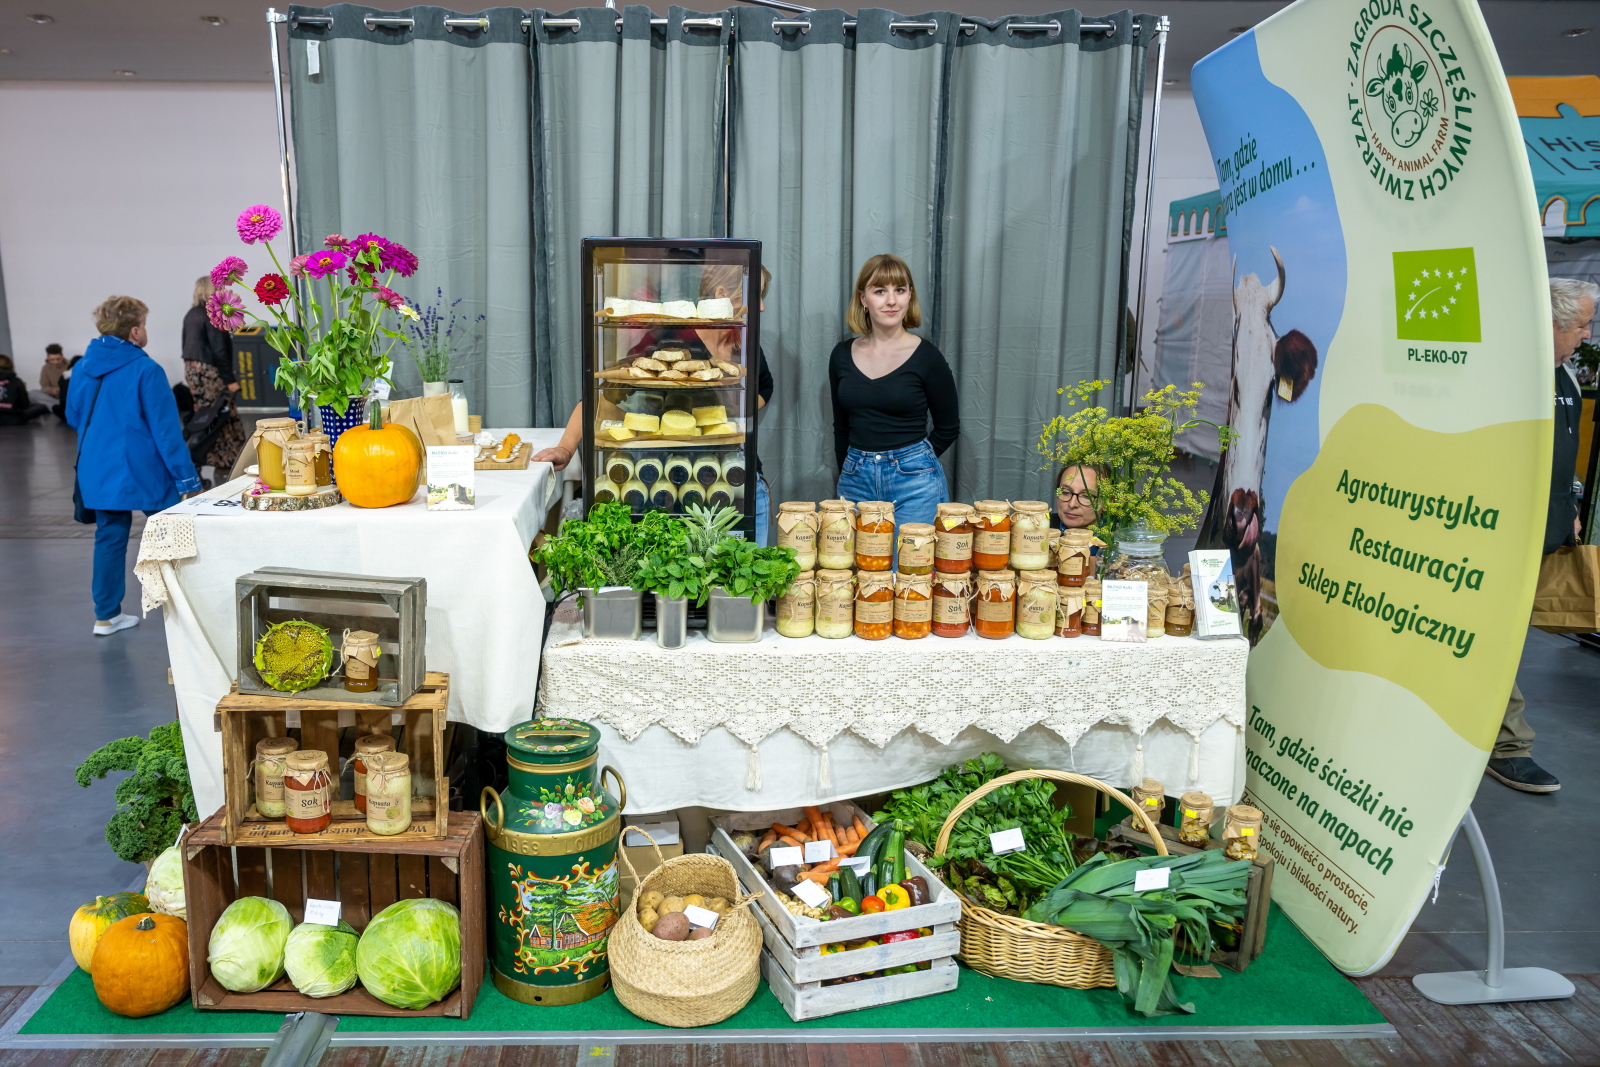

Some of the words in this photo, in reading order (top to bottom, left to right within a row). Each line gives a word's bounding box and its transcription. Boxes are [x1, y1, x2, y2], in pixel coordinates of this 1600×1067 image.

[1347, 0, 1405, 78] ZAGRODA
[1408, 3, 1477, 200] SZCZĘŚLIWYCH
[1233, 131, 1257, 181] gdzie
[1347, 92, 1415, 201] ZWIERZĄT
[1371, 132, 1397, 166] HAPPY
[1397, 153, 1434, 172] ANIMAL
[1431, 116, 1449, 155] FARM
[1248, 175, 1257, 199] w
[1407, 347, 1468, 365] PL-EKO-07
[1335, 469, 1500, 530] Agroturystyka
[955, 541, 969, 550] Sok
[1348, 527, 1485, 593] Restauracja
[1298, 562, 1340, 604] Sklep
[1341, 580, 1476, 659] Ekologiczny
[1248, 705, 1276, 749] Tam,
[1276, 736, 1320, 774] gdzie
[1318, 757, 1384, 815] ścieżki
[1377, 806, 1414, 838] nie
[301, 797, 318, 808] Sok
[1245, 745, 1298, 801] naczone
[1296, 791, 1320, 819] na
[1318, 808, 1394, 876] mapach
[503, 836, 541, 856] 1969
[1257, 834, 1287, 867] spokoju
[1268, 819, 1281, 837] się
[1280, 829, 1320, 868] opowieść
[1317, 862, 1325, 872] o
[1322, 868, 1369, 916] prostocie,
[1286, 858, 1293, 870] i
[1289, 861, 1329, 904] bliskości
[1325, 897, 1359, 935] natury.
